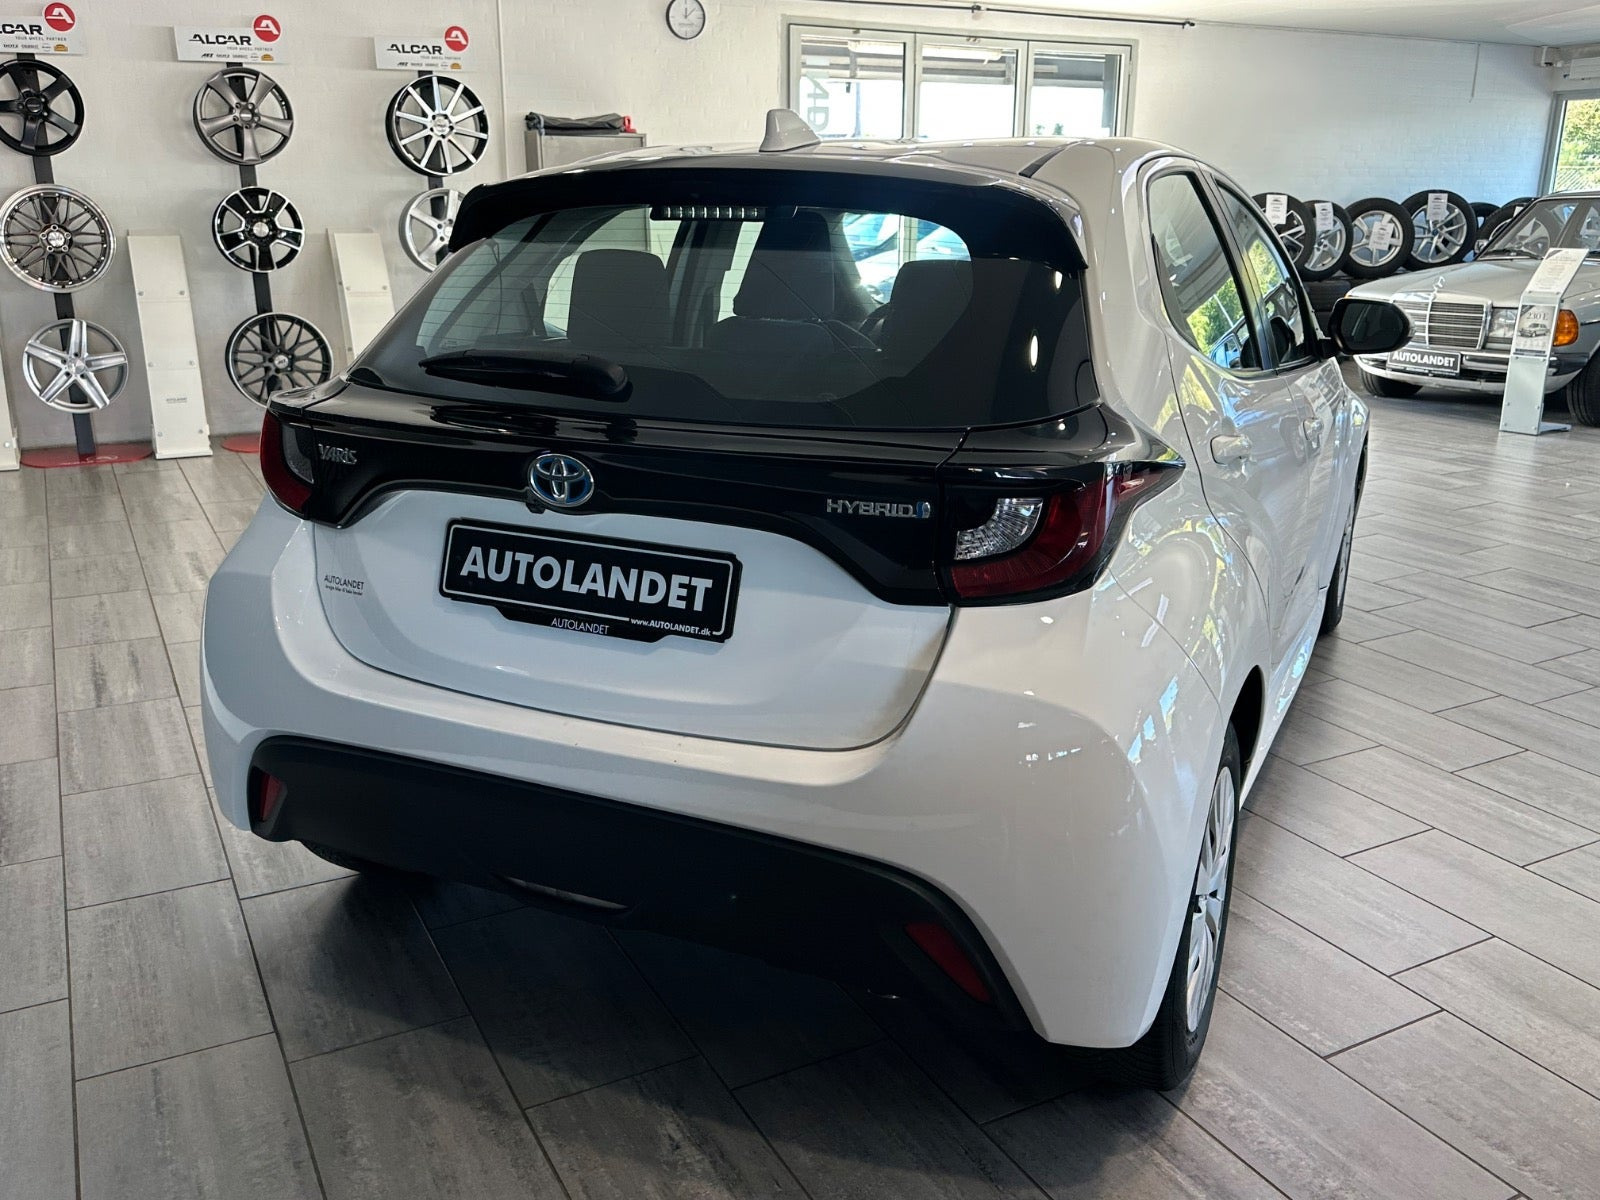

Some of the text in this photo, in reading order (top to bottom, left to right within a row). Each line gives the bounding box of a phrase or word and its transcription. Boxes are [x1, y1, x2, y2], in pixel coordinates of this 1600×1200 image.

[188, 33, 252, 46] ALCAR
[386, 43, 443, 55] ALCAR
[1392, 351, 1456, 367] AUTOLANDET
[826, 498, 914, 518] HYBRID
[323, 574, 365, 590] AUTOLANDET
[459, 546, 714, 613] AUTOLANDET
[551, 617, 610, 635] AUTOLANDET
[630, 617, 712, 637] www.AUTOLANDET.dk
